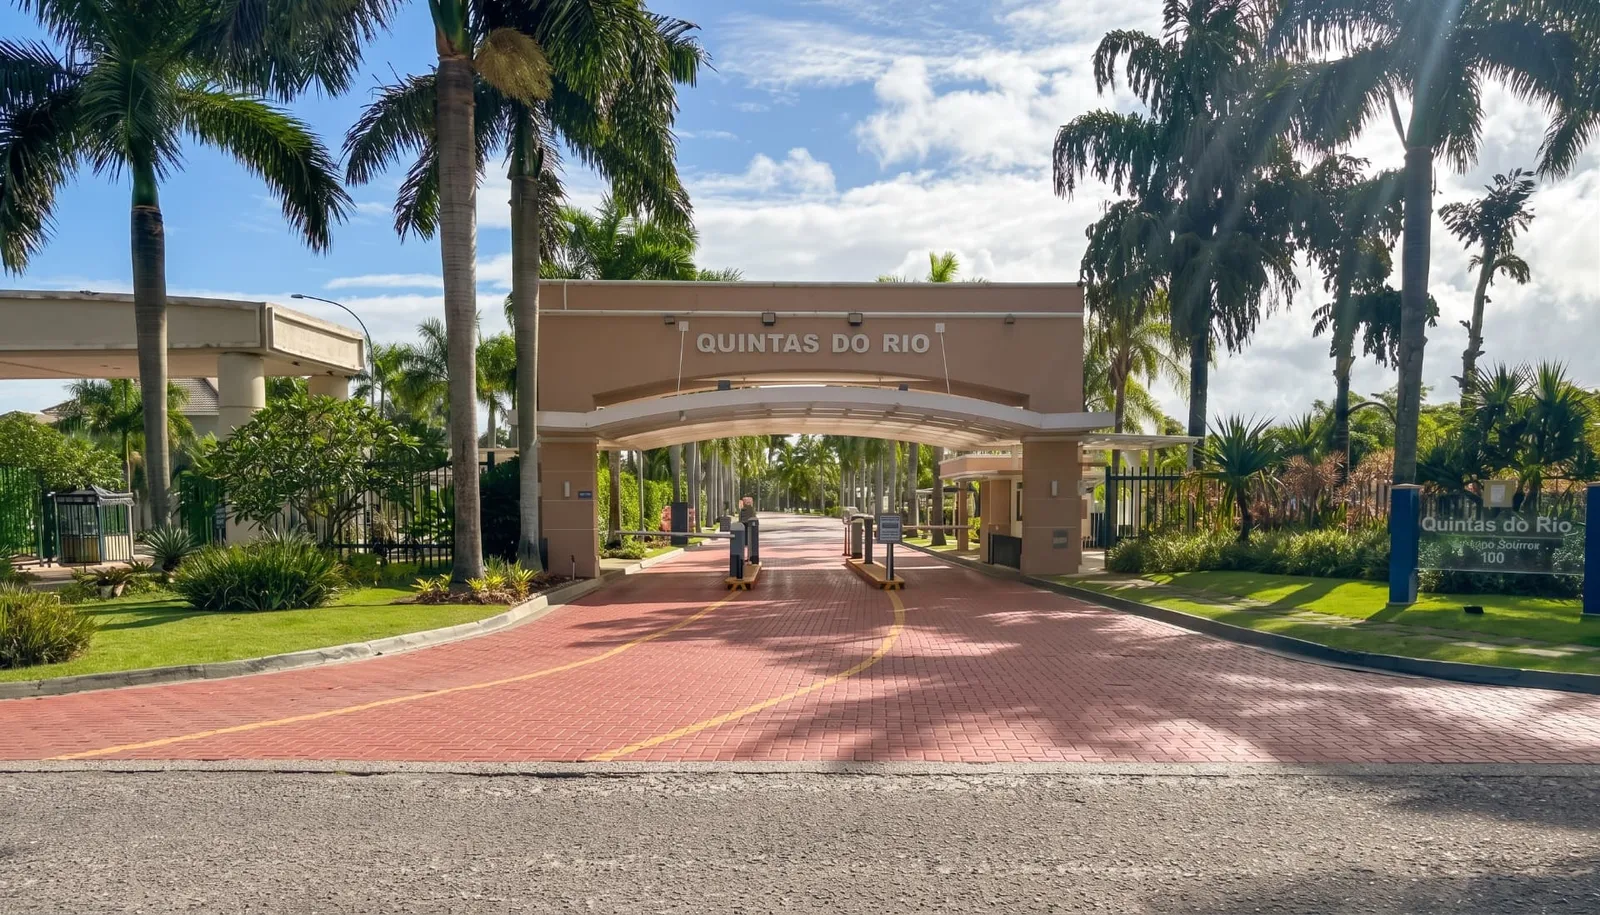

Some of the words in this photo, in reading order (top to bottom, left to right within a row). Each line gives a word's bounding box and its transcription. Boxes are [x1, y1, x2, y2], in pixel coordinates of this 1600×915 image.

[696, 333, 819, 354] QUINTAS
[832, 333, 870, 353] DO
[882, 333, 930, 353] RIO
[1421, 516, 1497, 532] Quintas
[1503, 517, 1529, 532] do
[1536, 516, 1573, 533] Rio
[1481, 551, 1505, 564] 100
